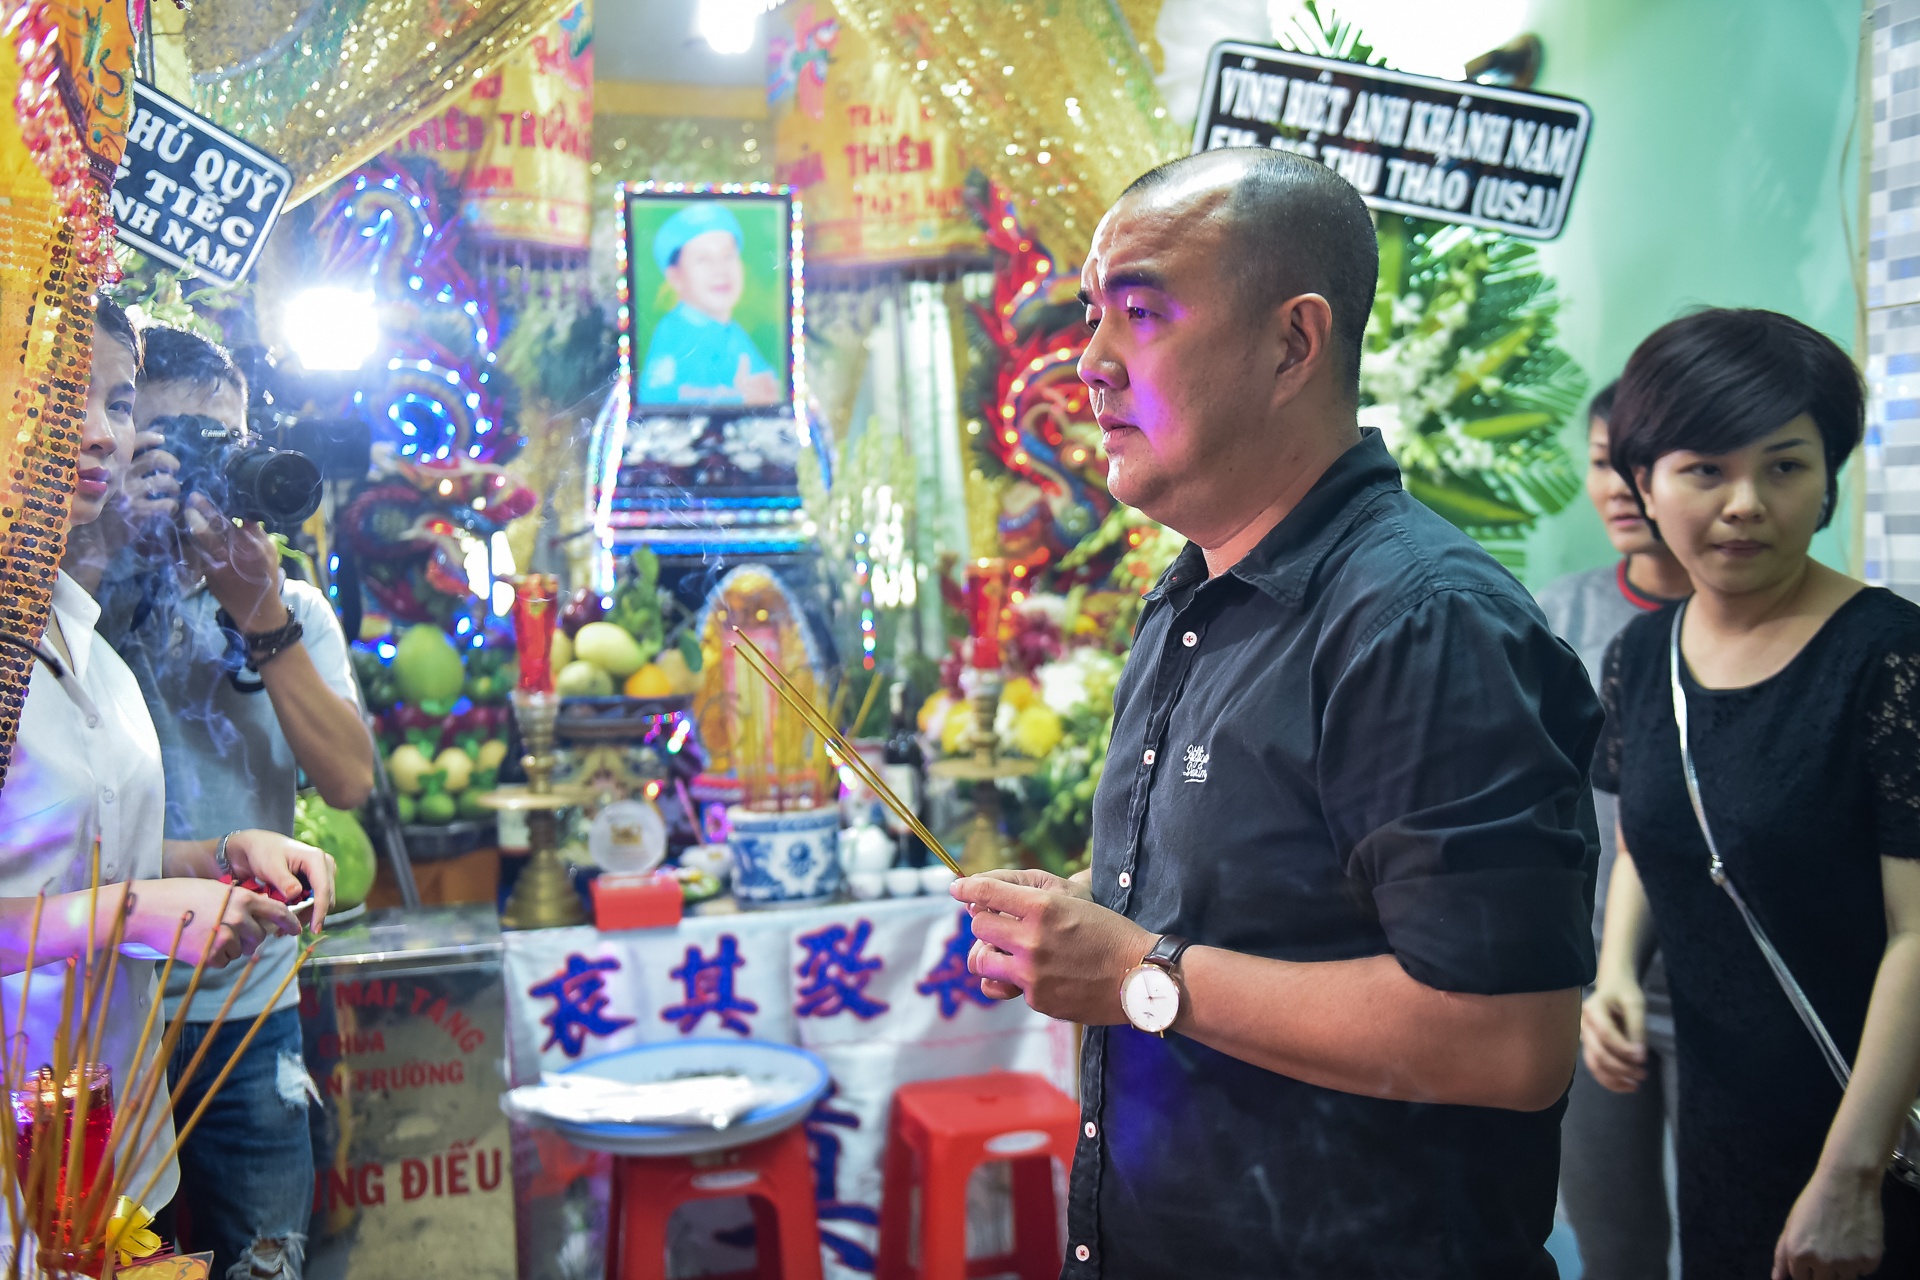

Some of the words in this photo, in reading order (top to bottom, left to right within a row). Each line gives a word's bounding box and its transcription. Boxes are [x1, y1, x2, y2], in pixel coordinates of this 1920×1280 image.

[126, 108, 194, 163] HÚ
[190, 148, 278, 212] QUÝ
[1342, 90, 1410, 148] ANH
[1403, 94, 1511, 166] KHÁNH
[1503, 118, 1576, 177] NAM
[110, 188, 161, 235] NH
[161, 219, 242, 277] NAM
[144, 170, 255, 247] TIẾC
[1471, 175, 1559, 229] (USA)
[335, 979, 399, 1008] MAI
[401, 1137, 502, 1201] ĐIẾU
